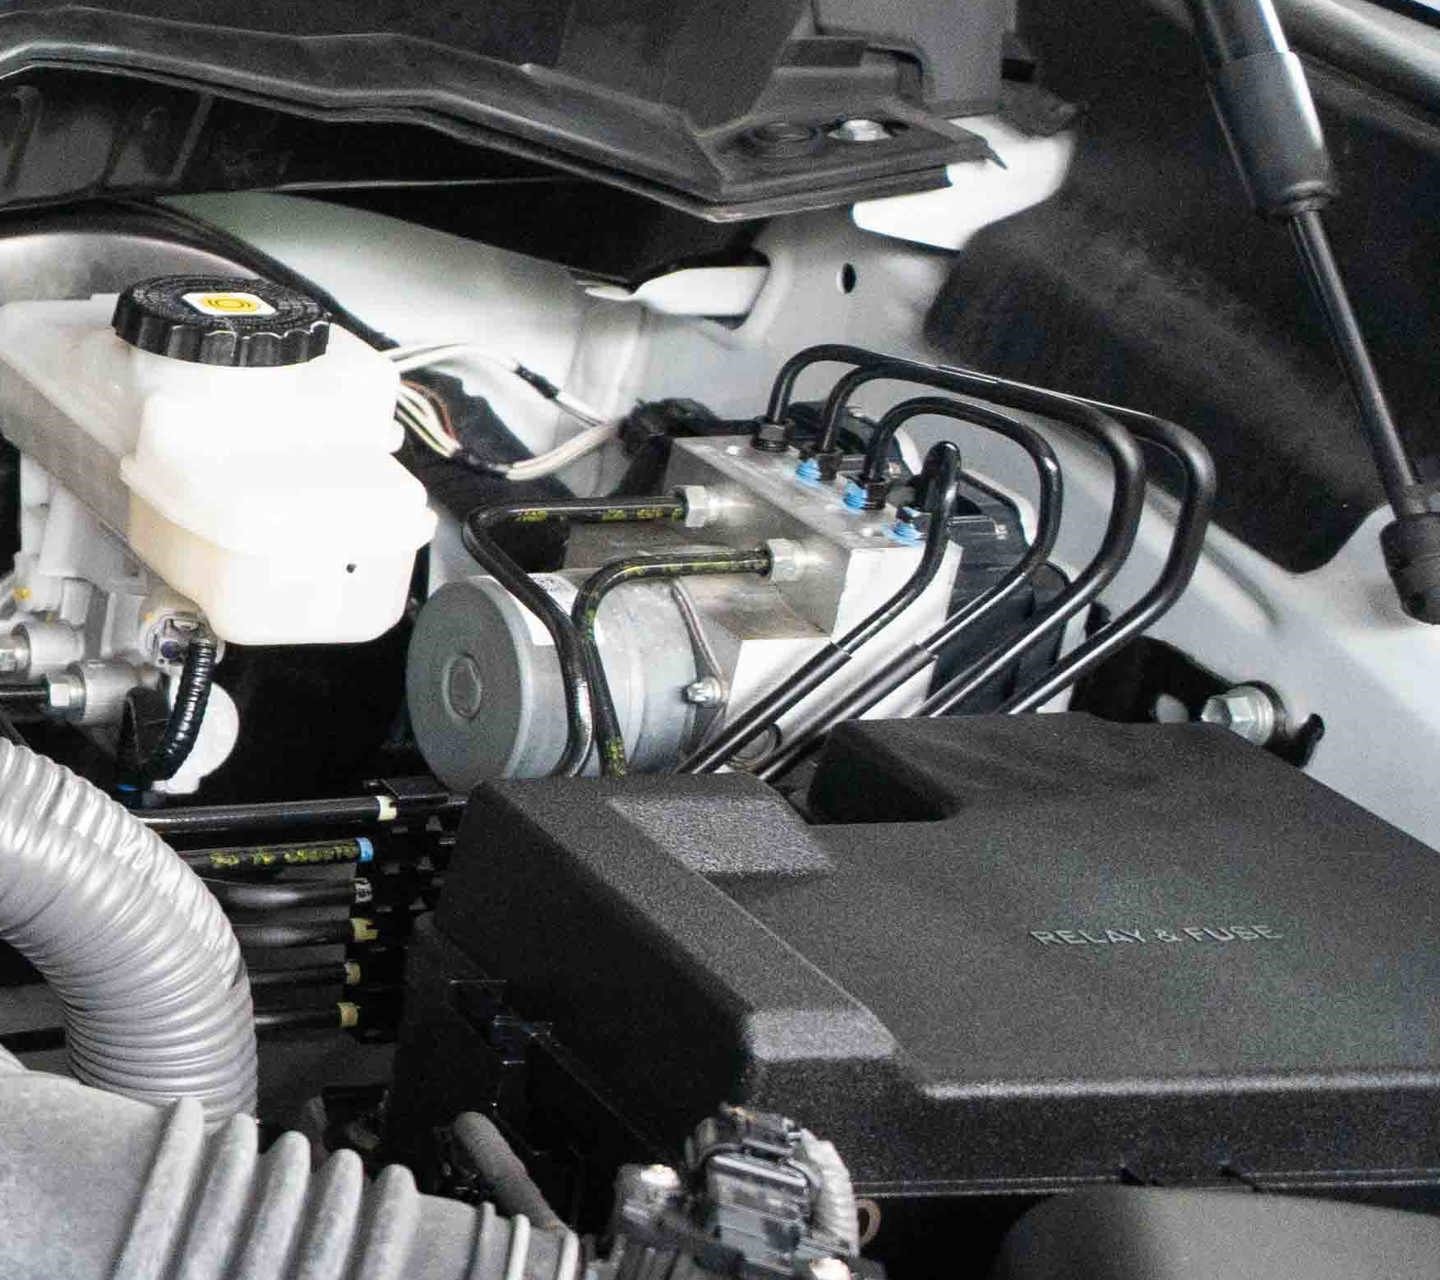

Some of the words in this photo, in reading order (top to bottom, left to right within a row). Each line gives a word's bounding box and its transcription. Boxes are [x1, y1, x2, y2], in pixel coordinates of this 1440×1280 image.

[1030, 929, 1146, 945] RELAY
[1154, 928, 1180, 942] &
[1183, 925, 1282, 941] FUSE
